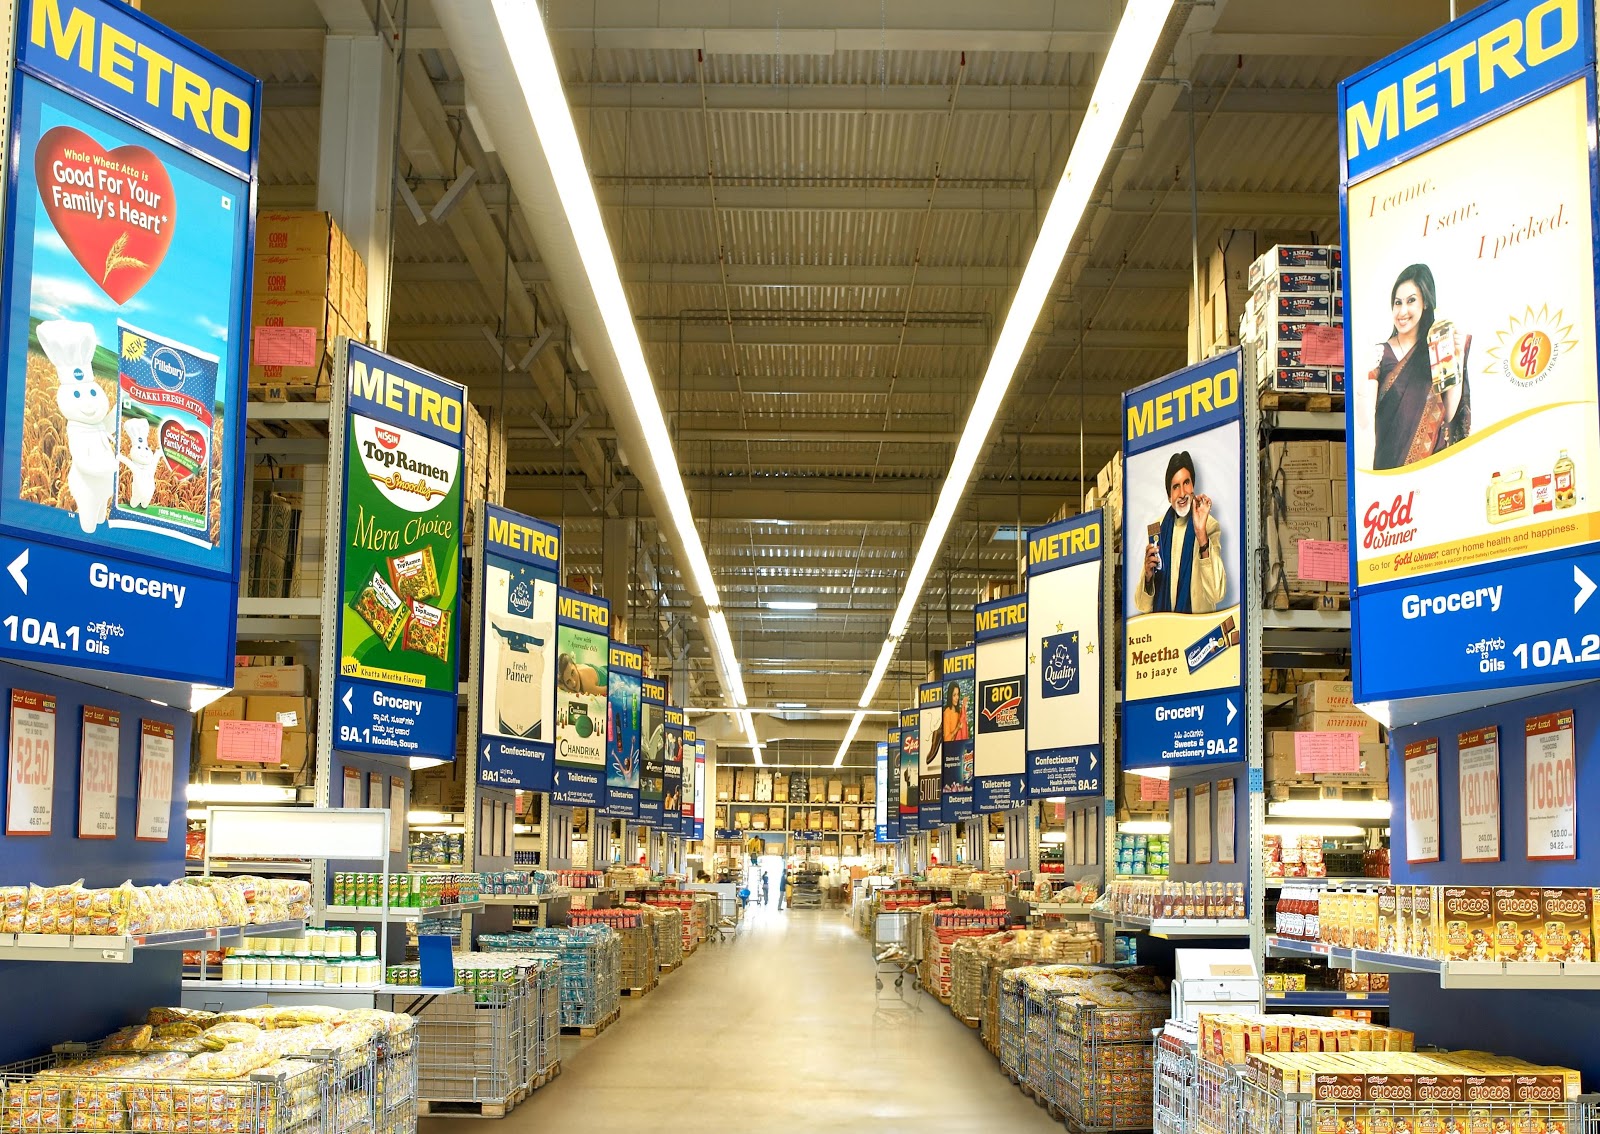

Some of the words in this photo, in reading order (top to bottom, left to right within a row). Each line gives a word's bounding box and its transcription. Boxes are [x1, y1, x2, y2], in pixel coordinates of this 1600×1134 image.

[31, 0, 251, 152] METRO
[1346, 0, 1578, 161] METRO
[64, 148, 90, 165] Whole
[93, 153, 119, 171] Wheat
[121, 163, 139, 178] Atta
[141, 170, 149, 181] is
[53, 160, 93, 189] Good
[98, 168, 123, 194] For
[128, 177, 160, 208] Your
[52, 185, 115, 219] Family's
[1368, 195, 1377, 218] I
[1382, 177, 1436, 212] came.
[1422, 214, 1430, 237] I
[1436, 202, 1479, 230] saw.
[269, 233, 288, 242] CORN
[1477, 235, 1485, 259] I
[1493, 203, 1568, 259] picked.
[268, 275, 286, 286] CORN
[265, 316, 284, 327] CORN
[126, 338, 142, 357] NEW
[153, 357, 184, 380] Pillsbury
[1509, 376, 1534, 388] WINNER
[129, 386, 160, 402] CHAKKI
[162, 393, 185, 405] FRESH
[185, 400, 202, 415] ATTA
[353, 360, 461, 434] METRO
[1127, 368, 1238, 441] METRO
[163, 438, 185, 453] Family's
[165, 429, 180, 440] Good
[180, 435, 190, 446] For
[190, 440, 202, 453] Your
[376, 431, 400, 445] NISSIN
[353, 504, 399, 550] Mera
[404, 515, 452, 548] Choice
[1363, 491, 1414, 549] Gold
[489, 516, 559, 561] METRO
[1029, 523, 1100, 565] METRO
[1369, 562, 1380, 572] Go
[1381, 560, 1390, 570] for
[1393, 553, 1412, 571] Gold
[1441, 546, 1461, 558] carry
[1462, 542, 1484, 553] home
[1486, 535, 1511, 548] health
[1513, 531, 1529, 542] and
[1531, 523, 1578, 540] happiness.
[1373, 527, 1417, 549] winner
[89, 562, 186, 609] Grocery
[558, 596, 609, 627] METRO
[1323, 595, 1334, 609] M
[1402, 585, 1503, 620] Grocery
[976, 602, 1026, 631] METRO
[3, 615, 80, 651] 10A.1
[86, 639, 110, 655] Oils
[1128, 634, 1152, 645] kuch
[610, 648, 641, 670] ETRO
[1131, 646, 1180, 666] Meetha
[1479, 658, 1505, 673] Oils
[1513, 633, 1600, 669] 10A.2
[343, 664, 357, 675] NEW
[513, 661, 527, 671] Fresh
[1045, 665, 1076, 685] Quality
[1136, 669, 1148, 679] ho
[1151, 667, 1178, 679] jaaye
[361, 668, 380, 678] Khatta
[381, 671, 402, 681] Meetha
[403, 674, 423, 685] Flavour
[506, 668, 533, 684] Paneer
[373, 691, 422, 715] Grocery
[991, 685, 1013, 702] aro
[1155, 705, 1205, 722] Grocery
[1345, 719, 1368, 727] LYCHEE
[1557, 716, 1572, 725] METRO
[340, 725, 370, 743] 9A.1
[372, 736, 399, 748] Noodles,
[399, 739, 418, 750] Soups
[1174, 739, 1197, 749] Sweets
[1199, 738, 1204, 746] &
[500, 744, 545, 761] Confectionary
[560, 738, 600, 757] CHANDRIKA
[1162, 749, 1205, 759] Confectionery
[1206, 737, 1238, 755] 9A.2
[16, 736, 49, 786] 52.50
[1035, 755, 1079, 766] Confectionary
[86, 750, 114, 793] 52.50
[247, 771, 257, 781] M
[482, 769, 499, 782] 8A.1
[1078, 779, 1098, 791] 8A.2
[1326, 786, 1337, 797] M
[1461, 769, 1497, 817] 180.00
[1530, 758, 1573, 810] 106.00
[553, 791, 567, 802] 7A.1
[1011, 799, 1025, 808] 7A.2
[1410, 778, 1433, 822] 60.00
[1550, 841, 1564, 850] 94.22
[1448, 899, 1489, 912] CHOCOS
[1497, 899, 1539, 912] CHOCOS
[1545, 899, 1587, 913] CHOCOS
[1318, 1086, 1361, 1098] CHOCOS
[1369, 1086, 1412, 1098] CHOCOS
[1419, 1086, 1462, 1099] CHOCOS
[1468, 1086, 1511, 1099] CHOCOS
[1518, 1086, 1561, 1099] CHOCOS
